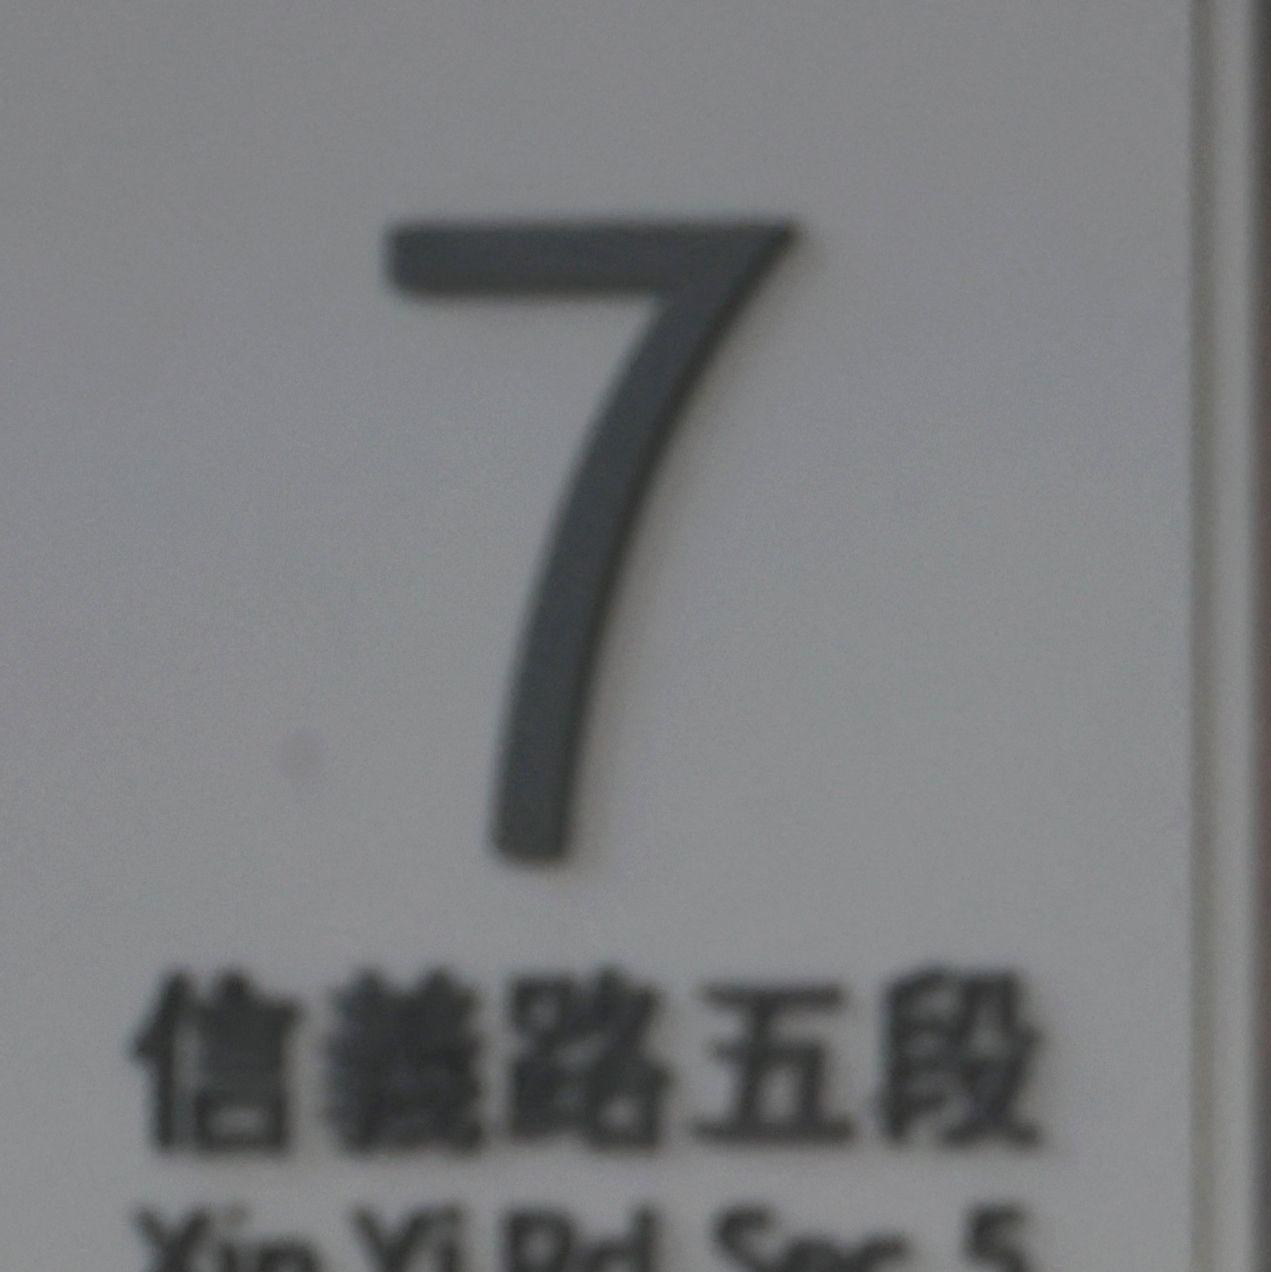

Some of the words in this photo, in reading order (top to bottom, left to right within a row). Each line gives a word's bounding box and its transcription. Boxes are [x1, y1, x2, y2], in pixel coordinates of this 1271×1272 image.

[387, 218, 803, 867] 7
[130, 966, 1045, 1158] 信義路五段
